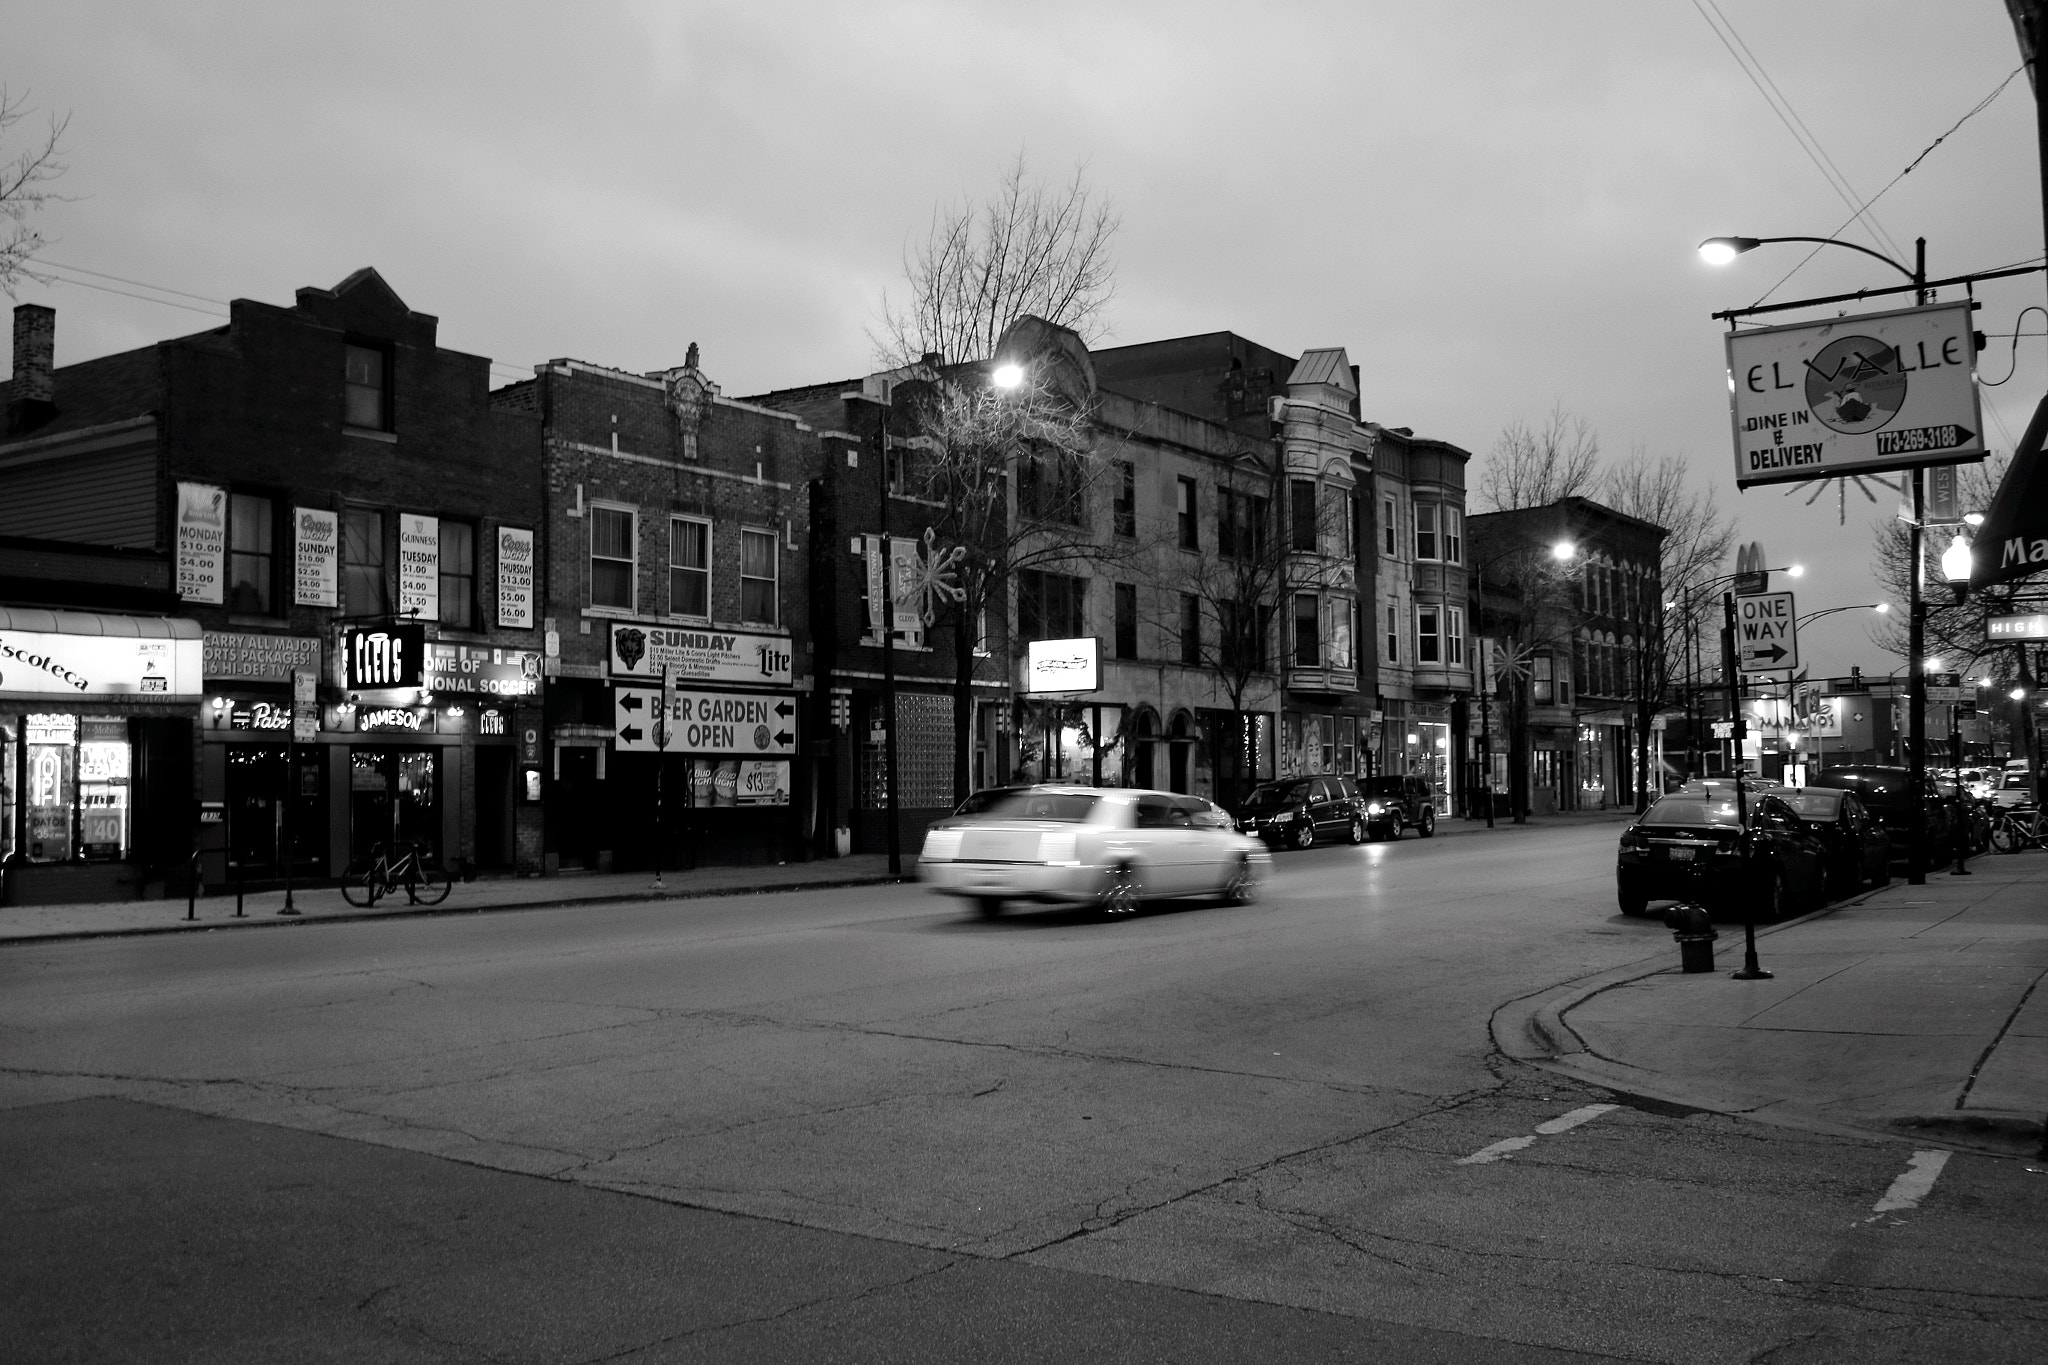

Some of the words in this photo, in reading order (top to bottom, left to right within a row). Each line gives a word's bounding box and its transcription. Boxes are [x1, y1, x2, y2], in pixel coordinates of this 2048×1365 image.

[1747, 362, 1794, 393] EL
[1802, 336, 1962, 382] VALLE
[1747, 413, 1788, 432] DINE
[1792, 409, 1809, 425] IN
[1878, 425, 1957, 453] 773-269-3188
[1750, 442, 1824, 471] DELIVERY
[180, 526, 223, 542] MONDAY
[402, 532, 436, 546] GUINNESS
[180, 540, 222, 554] $10.00
[298, 542, 335, 556] SUNDAY
[502, 534, 531, 553] Coors
[180, 557, 214, 569] $4.00
[298, 554, 325, 564] $10.00
[402, 550, 437, 564] TUESDAY
[298, 568, 320, 576] $2.50
[402, 564, 427, 574] $1.00
[500, 562, 532, 576] THURSDAY
[870, 550, 878, 580] TOWN
[180, 572, 214, 583] $3.00
[298, 580, 320, 588] $4.00
[500, 574, 531, 586] $13.00
[402, 580, 427, 591] $4.00
[402, 596, 427, 606] $1.50
[500, 592, 526, 602] $5.00
[500, 607, 526, 618] $6.00
[1744, 599, 1787, 620] ONE
[1743, 620, 1789, 640] WAY
[1992, 621, 2040, 634] HIGH
[203, 634, 245, 648] CARRY
[248, 636, 271, 650] ALL
[274, 638, 318, 653] MAJOR
[650, 630, 736, 651] SUNDAY
[241, 650, 311, 666] PACKAGES!
[660, 647, 674, 655] Miller
[707, 650, 720, 659] Light
[664, 654, 680, 662] Select
[222, 662, 267, 676] HI-DEF
[461, 660, 481, 674] OF
[760, 648, 790, 678] Lite
[479, 680, 537, 696] SOCCER
[252, 702, 291, 729] Pabs
[651, 696, 693, 721] BER
[698, 698, 768, 724] GARDEN
[360, 709, 422, 731] JAMESON
[687, 724, 734, 748] OPEN
[714, 778, 736, 788] LIGHT
[746, 772, 764, 792] $13
